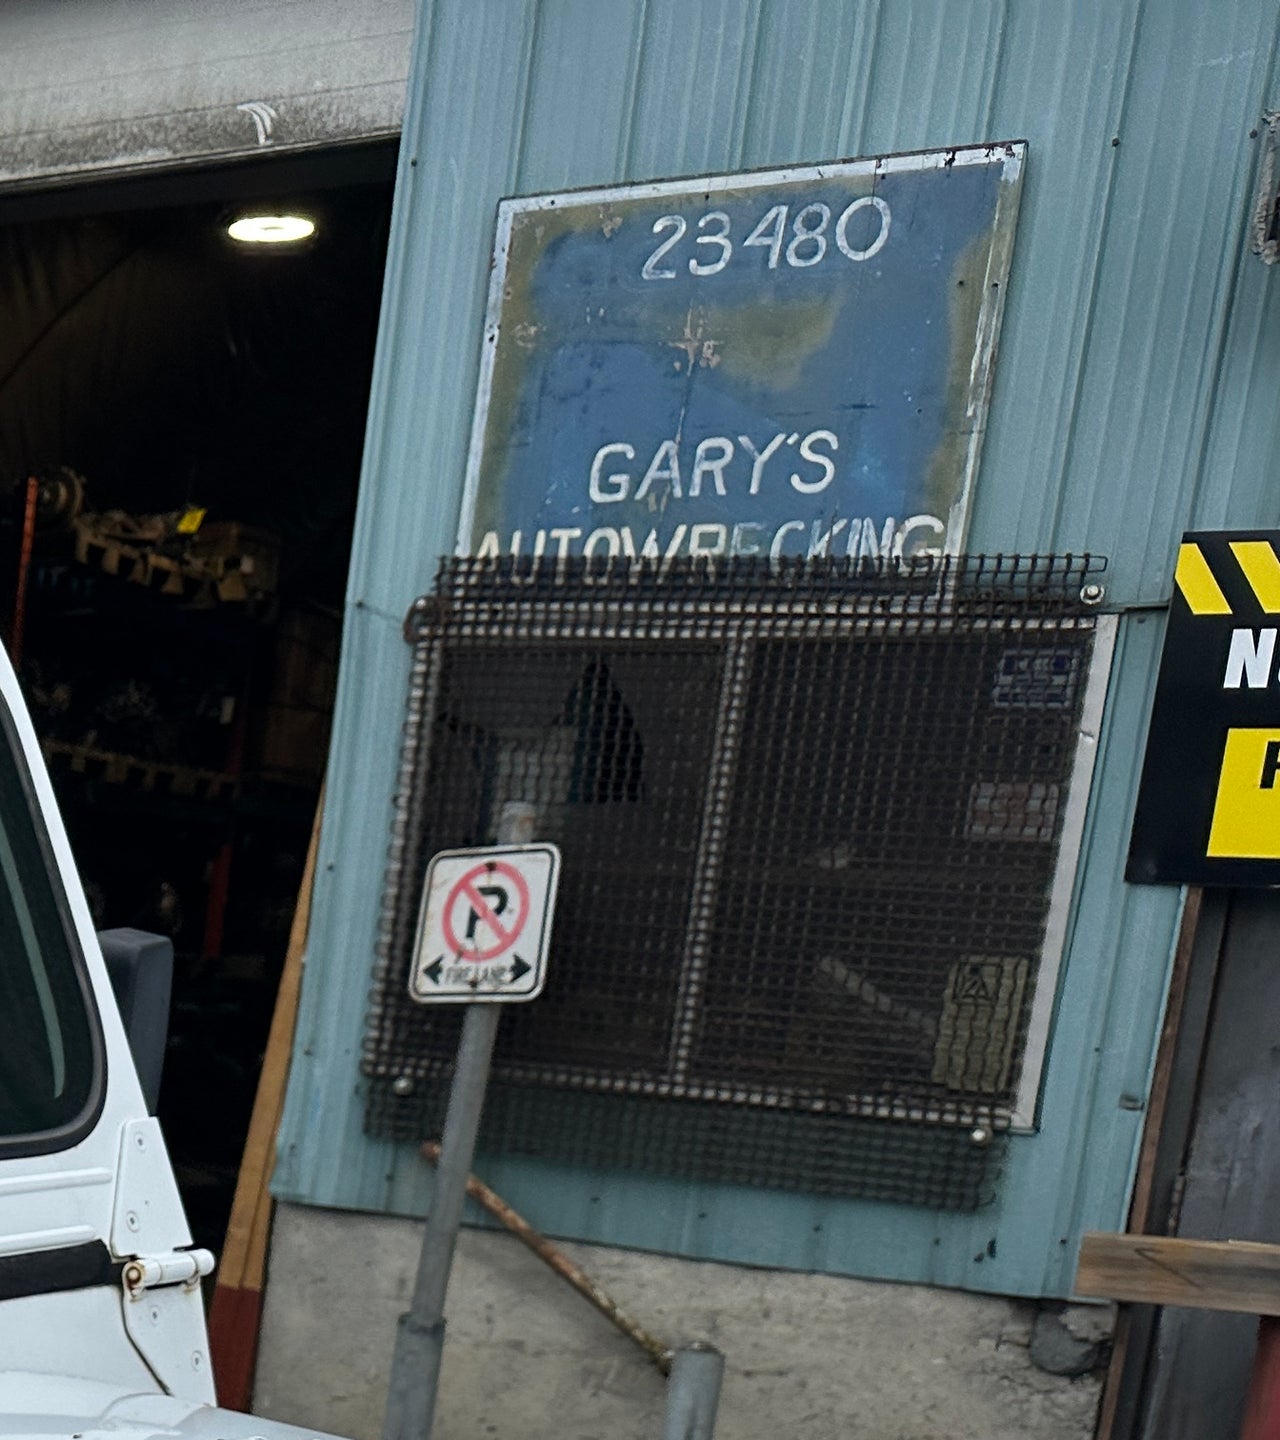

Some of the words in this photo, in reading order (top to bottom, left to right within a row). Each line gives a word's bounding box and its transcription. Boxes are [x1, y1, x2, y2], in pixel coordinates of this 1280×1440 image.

[640, 195, 892, 281] 23480
[588, 429, 840, 504] GARY'S
[1223, 628, 1280, 689] N
